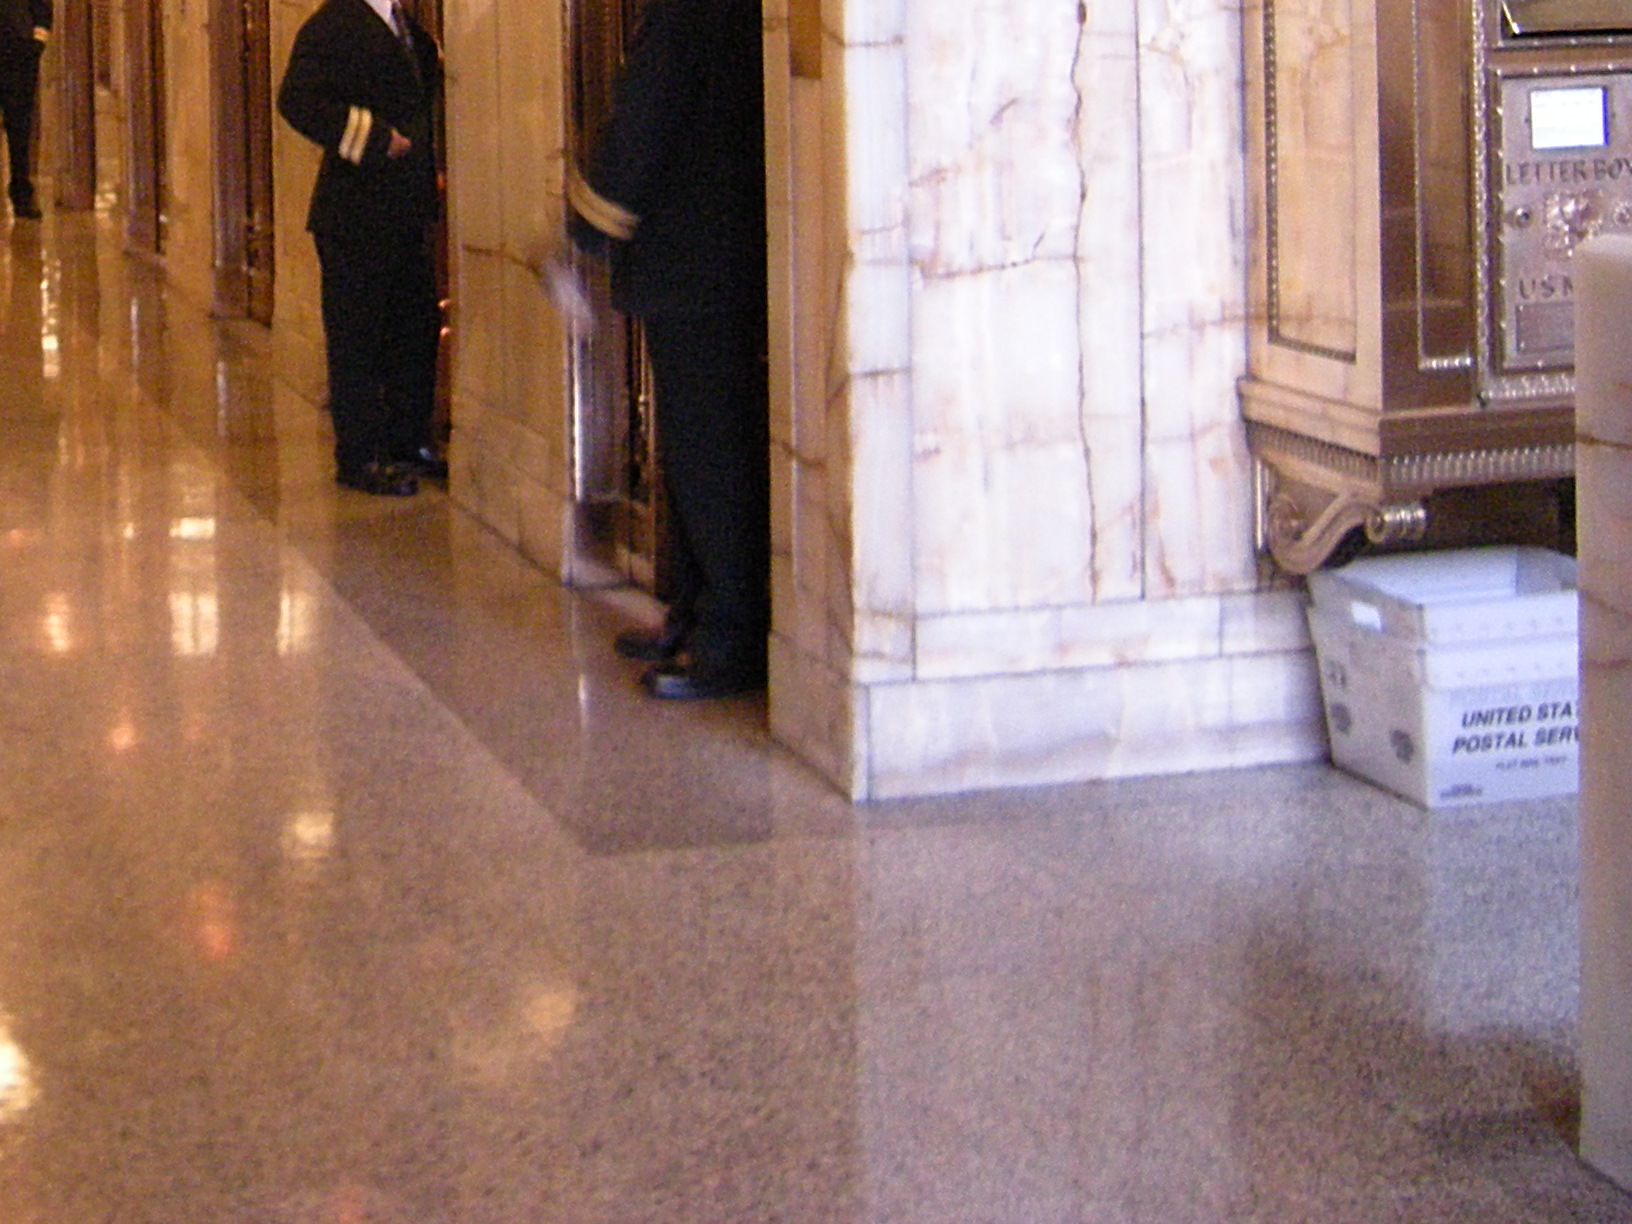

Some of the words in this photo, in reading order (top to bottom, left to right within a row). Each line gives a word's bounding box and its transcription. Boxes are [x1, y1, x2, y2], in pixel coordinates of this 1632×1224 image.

[1505, 160, 1588, 186] LETTER
[1461, 704, 1533, 729] UNITED
[1536, 700, 1579, 721] STA
[1451, 729, 1528, 755] POSTAL
